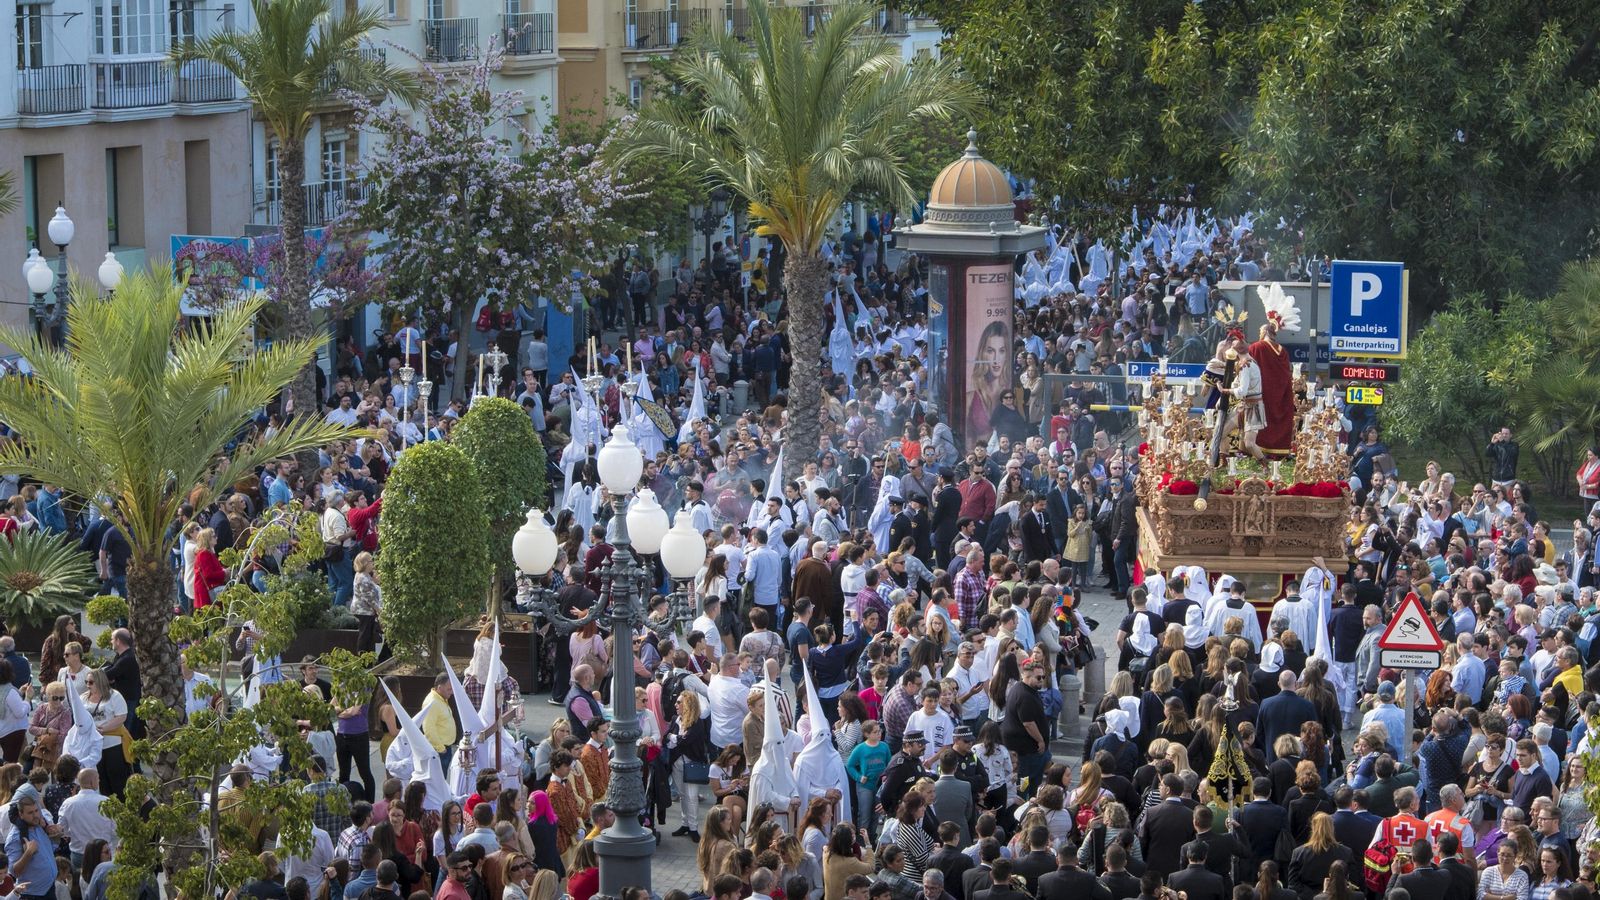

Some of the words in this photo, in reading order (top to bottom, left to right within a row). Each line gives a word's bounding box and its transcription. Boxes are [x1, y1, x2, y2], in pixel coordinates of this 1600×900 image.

[1350, 272, 1383, 317] P
[1343, 323, 1388, 335] Canalejas
[1345, 340, 1395, 351] Interparking
[1343, 367, 1386, 379] COMPLETO
[1349, 388, 1363, 402] 14
